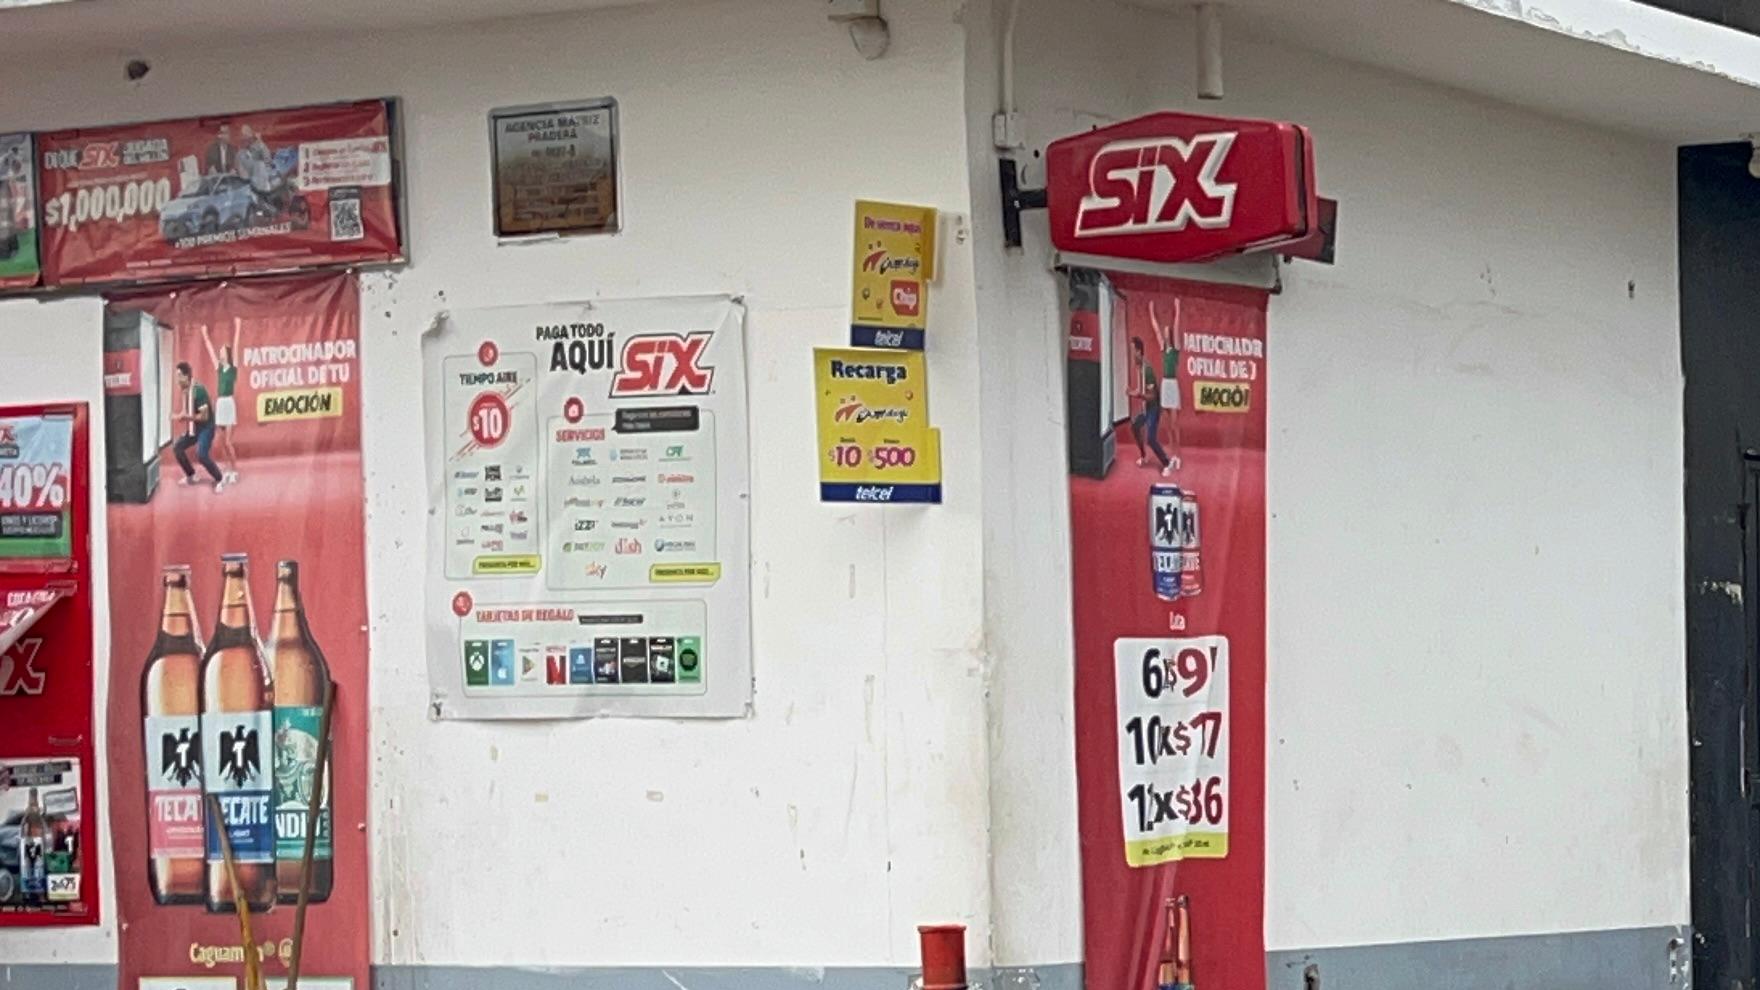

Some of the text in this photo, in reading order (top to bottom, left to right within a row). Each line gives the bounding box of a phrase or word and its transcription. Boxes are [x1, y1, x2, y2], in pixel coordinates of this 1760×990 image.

[1074, 131, 1238, 238] SIX
[243, 339, 356, 367] PATROCINADOR
[549, 332, 615, 375] AQUÍ
[609, 331, 714, 398] SIX
[250, 363, 349, 388] OFICIAL DE TU
[831, 360, 907, 384] Recarga
[264, 393, 331, 416] EMOCIÓN
[856, 486, 894, 500] telcel
